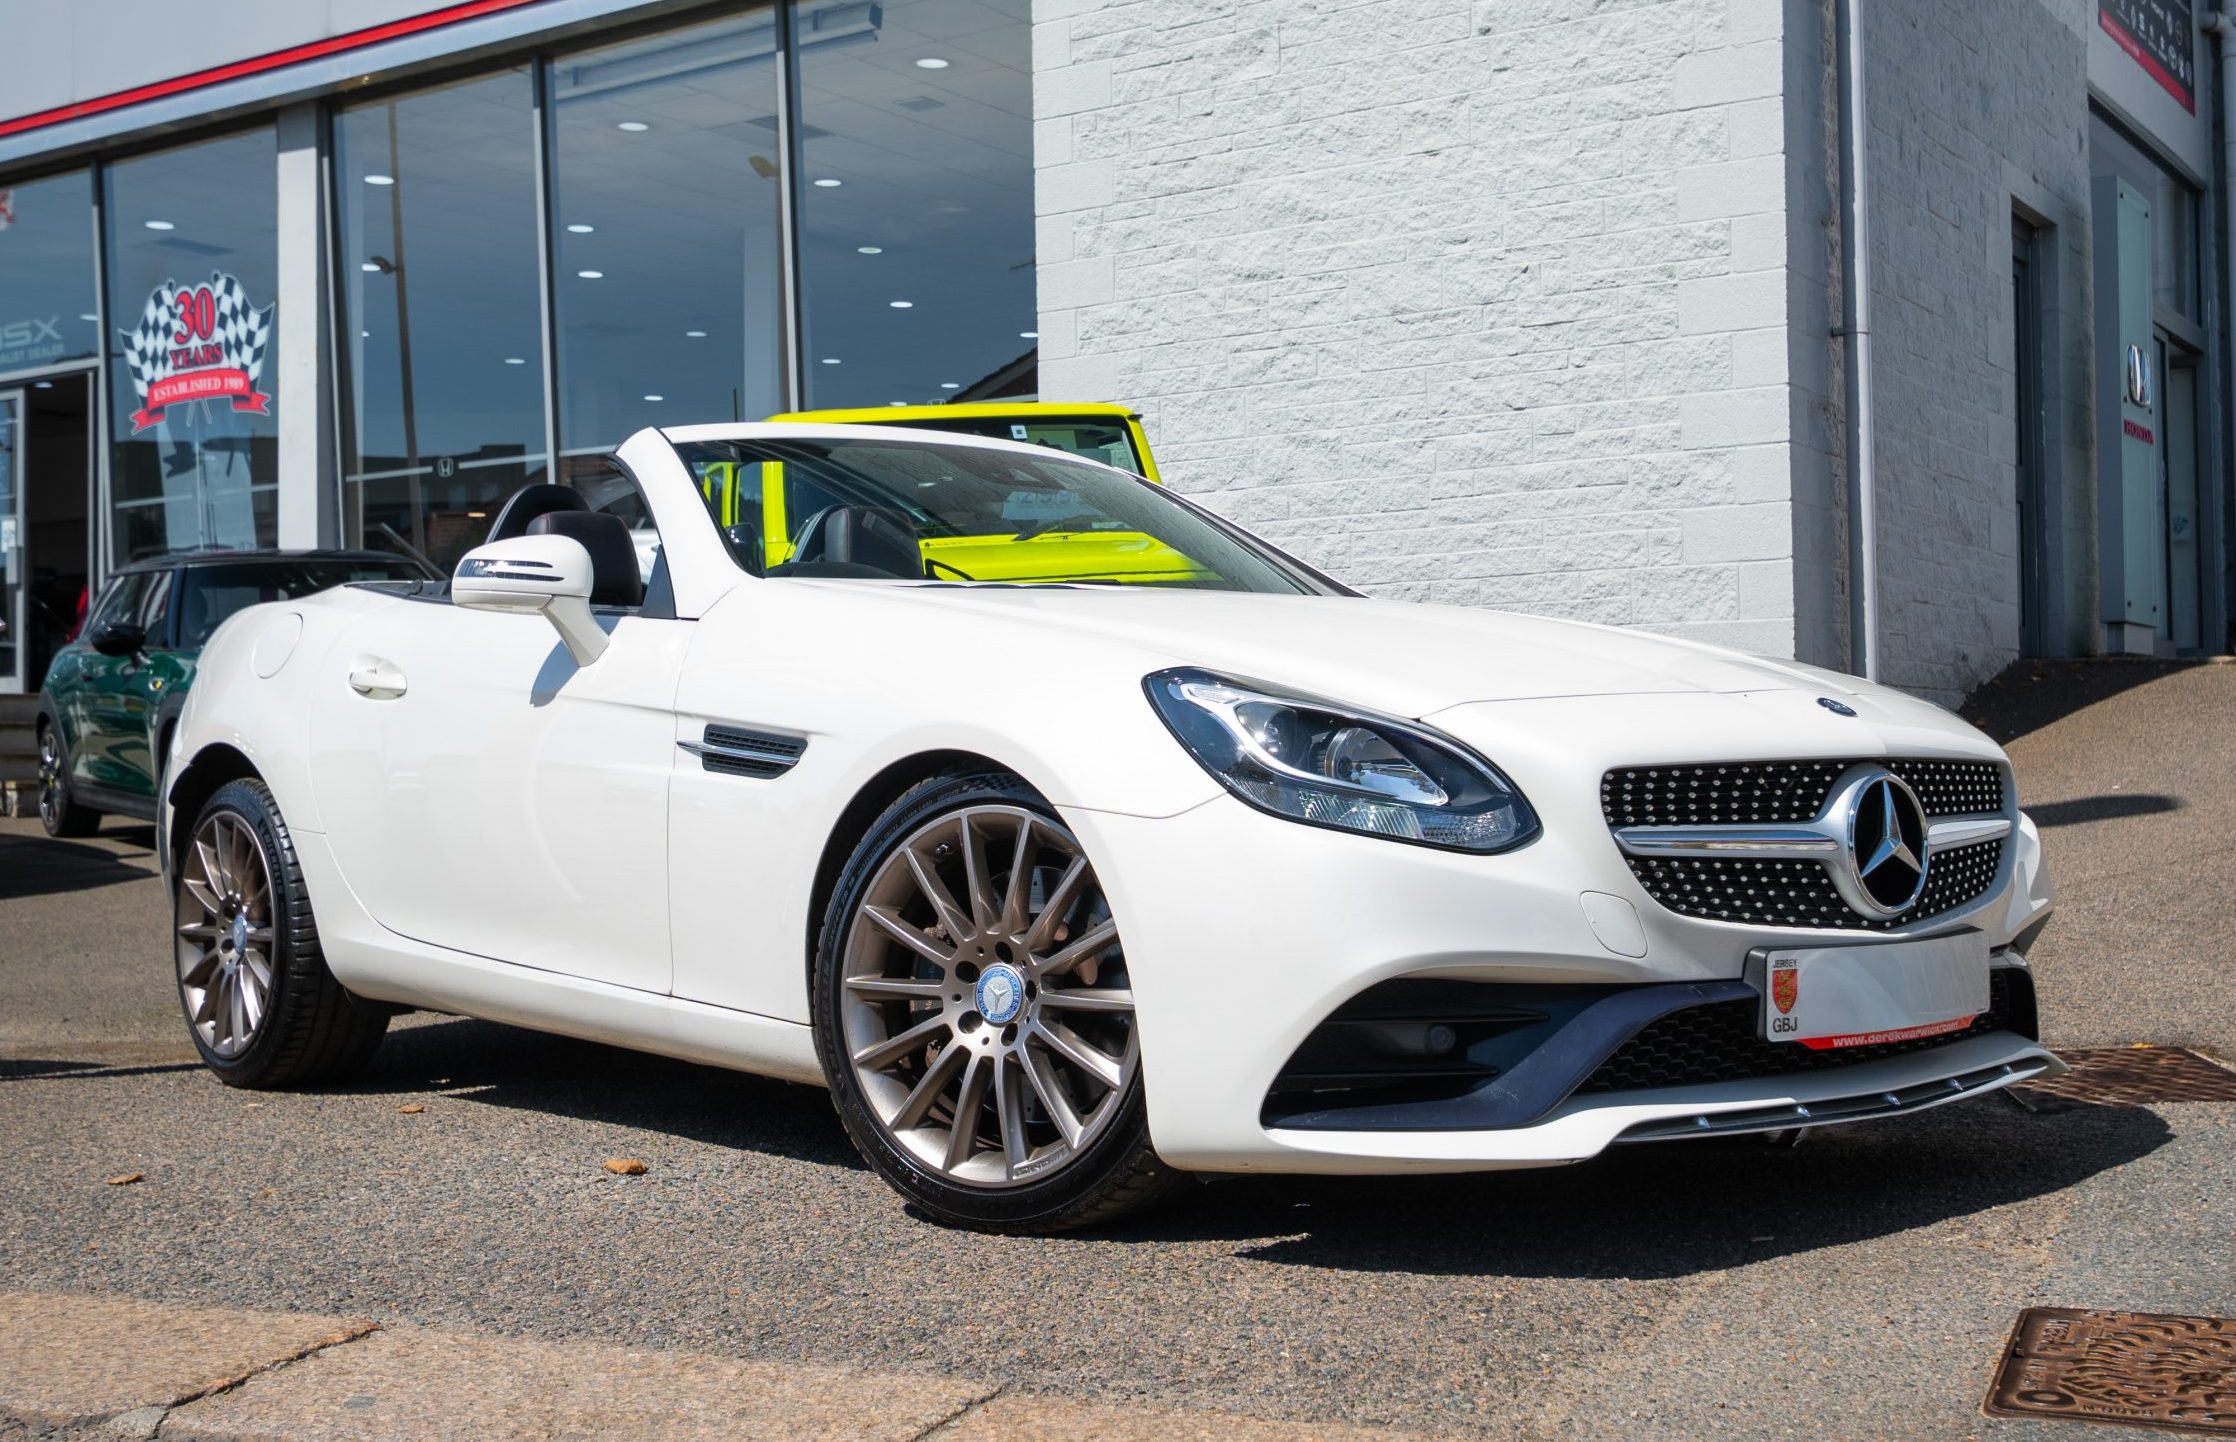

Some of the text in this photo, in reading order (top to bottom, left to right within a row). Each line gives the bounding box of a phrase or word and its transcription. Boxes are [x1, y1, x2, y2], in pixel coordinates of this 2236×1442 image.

[173, 286, 216, 346] 30
[0, 315, 63, 351] SX
[169, 342, 224, 371] YEARS
[153, 376, 222, 402] ESTABLISHED
[2123, 418, 2155, 446] HONDA
[1772, 958, 1798, 969] JERSEY
[1772, 1017, 1798, 1033] GBJ
